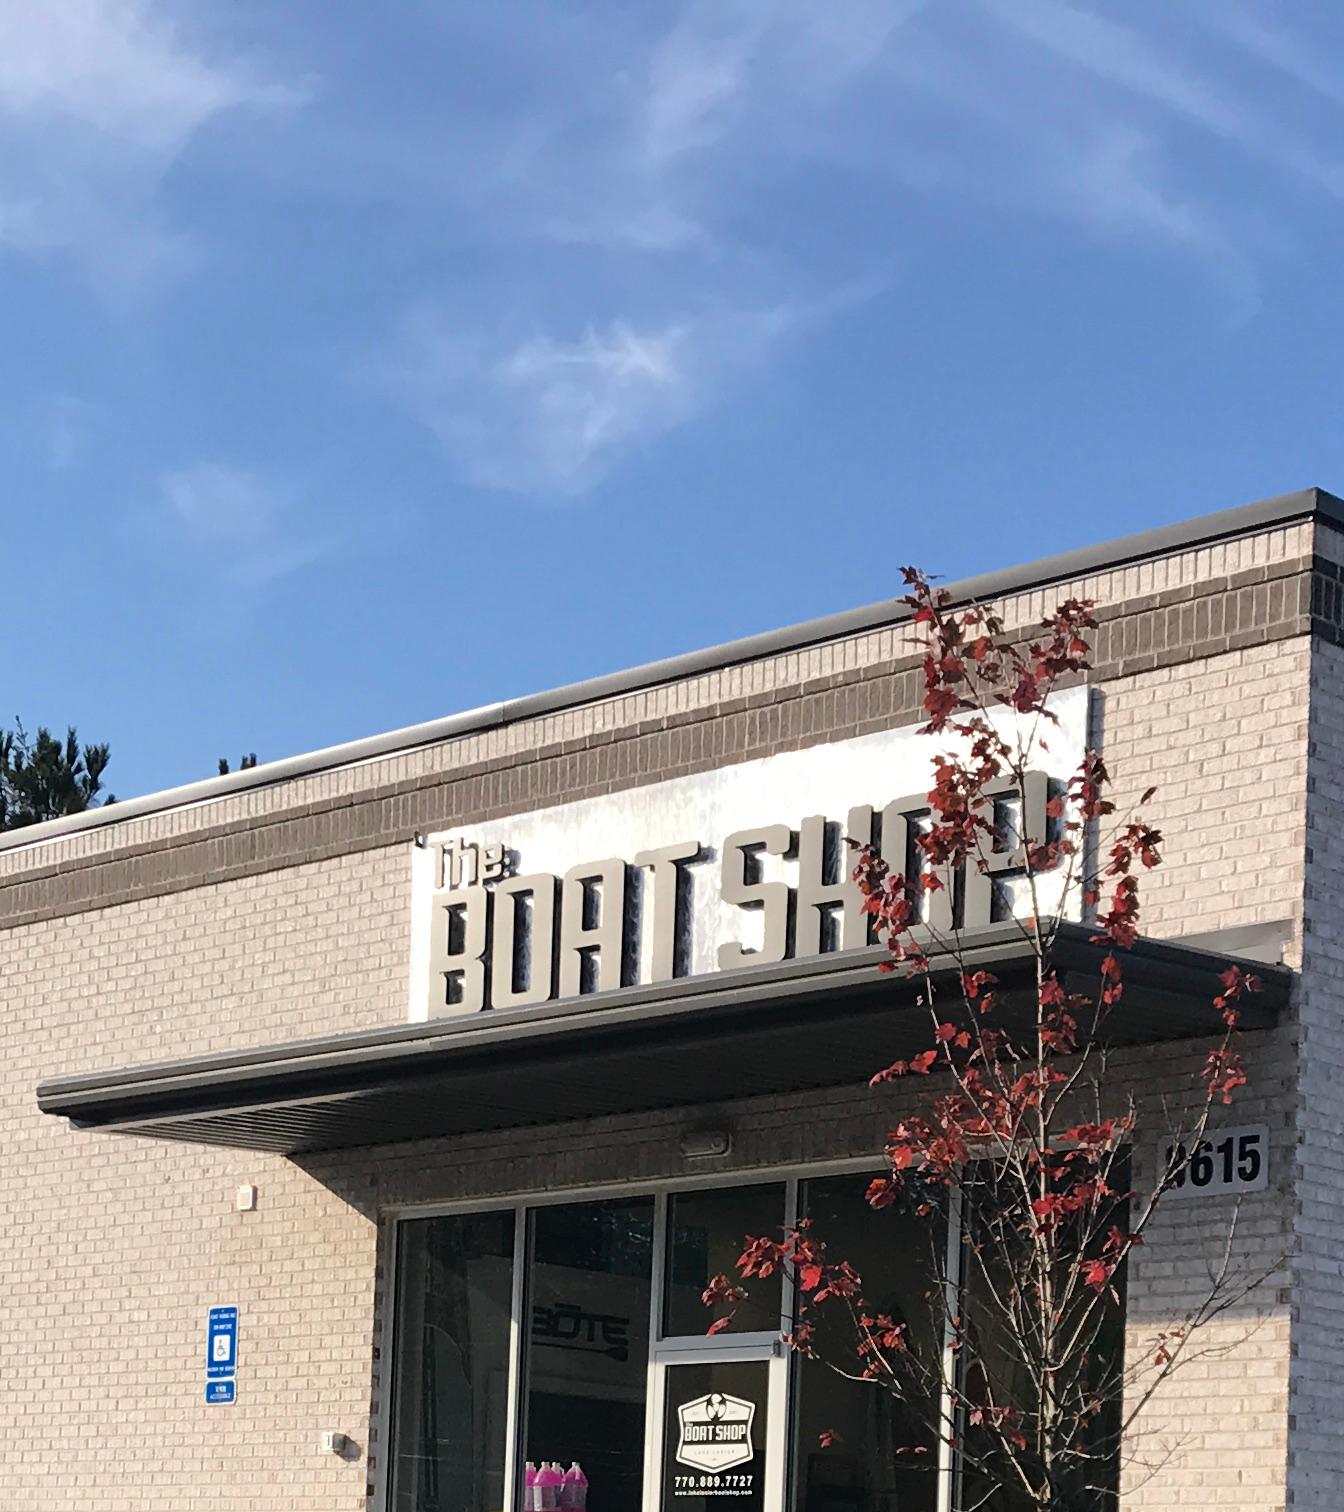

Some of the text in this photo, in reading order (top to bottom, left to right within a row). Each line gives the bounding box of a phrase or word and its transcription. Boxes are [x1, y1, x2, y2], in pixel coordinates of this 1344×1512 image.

[428, 837, 506, 891] The
[428, 770, 1049, 1020] BOAT SHOP
[684, 1424, 747, 1441] BOAT SHOP
[674, 1475, 753, 1488] 770.889.7727
